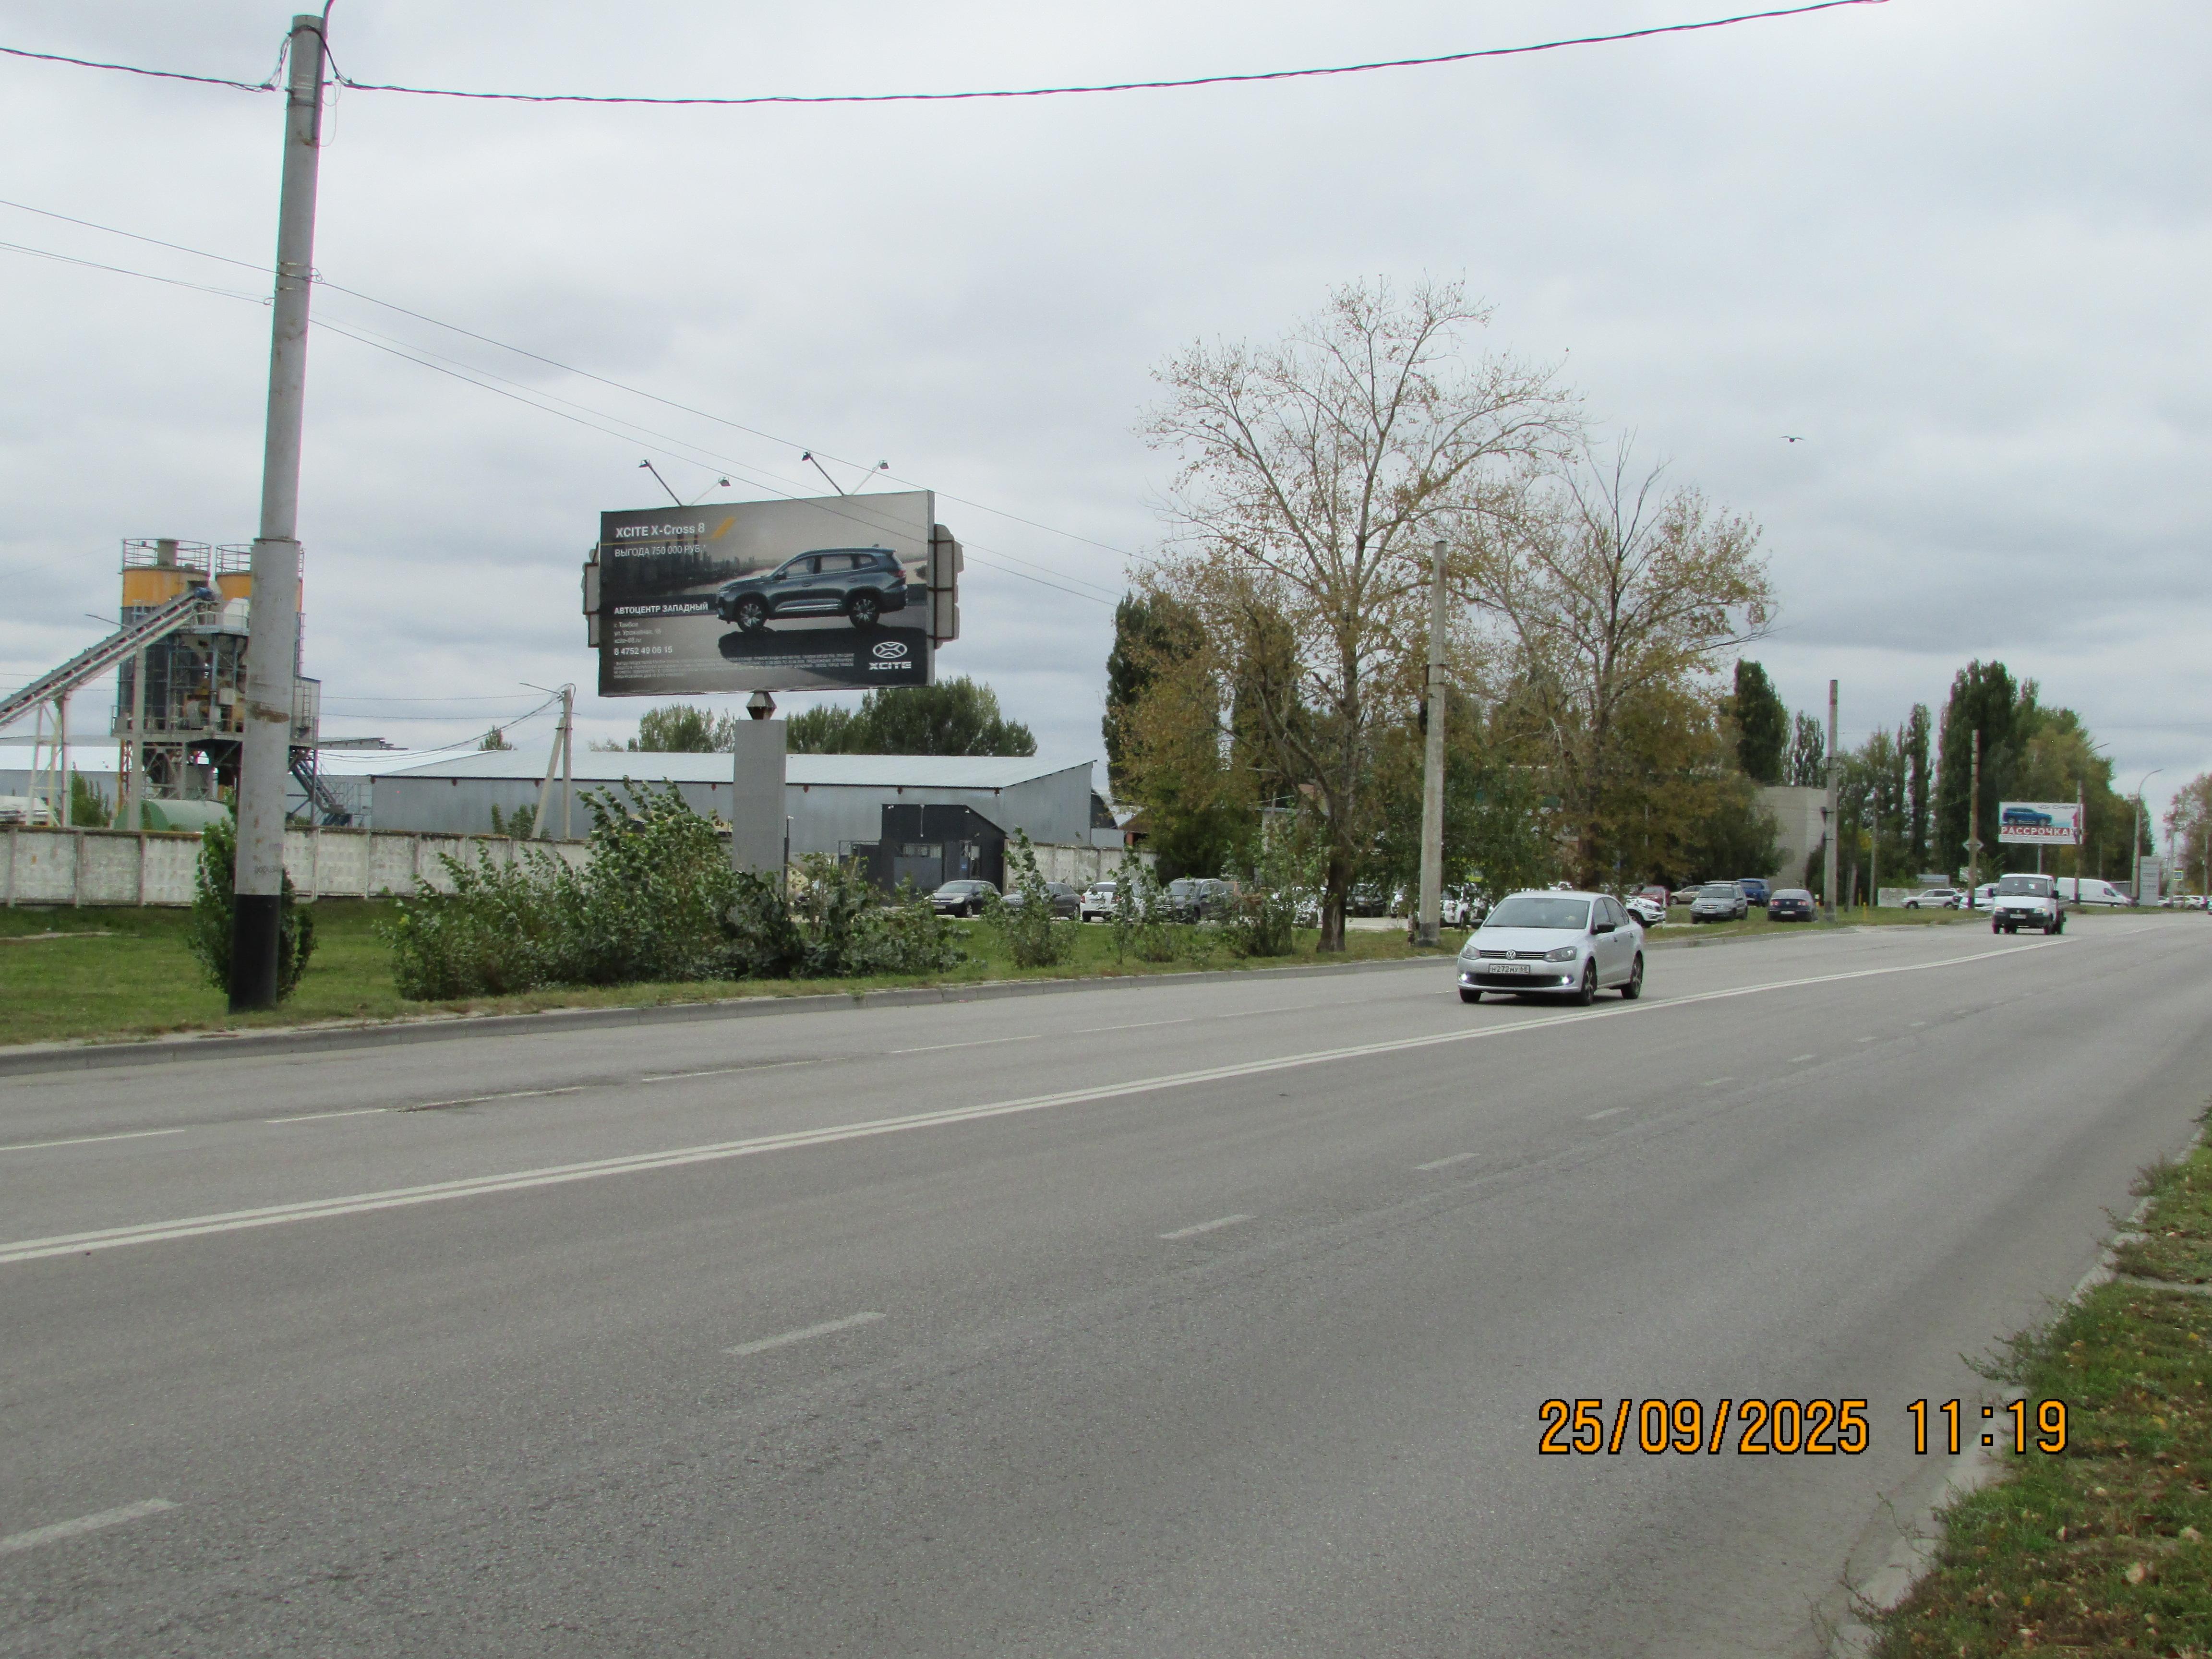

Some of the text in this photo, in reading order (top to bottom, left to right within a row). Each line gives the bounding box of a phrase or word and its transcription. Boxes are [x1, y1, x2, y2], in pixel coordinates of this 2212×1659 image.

[615, 522, 705, 538] XCITE X-Cross 8
[614, 547, 650, 557] ВЫГОДА
[651, 546, 666, 555] 750
[667, 545, 683, 554] 000
[614, 601, 708, 615] АВТОЦЕНТР ЗАПАДНЫЙ
[614, 648, 619, 656] 8
[620, 647, 639, 655] 4752
[868, 661, 912, 670] XCITE
